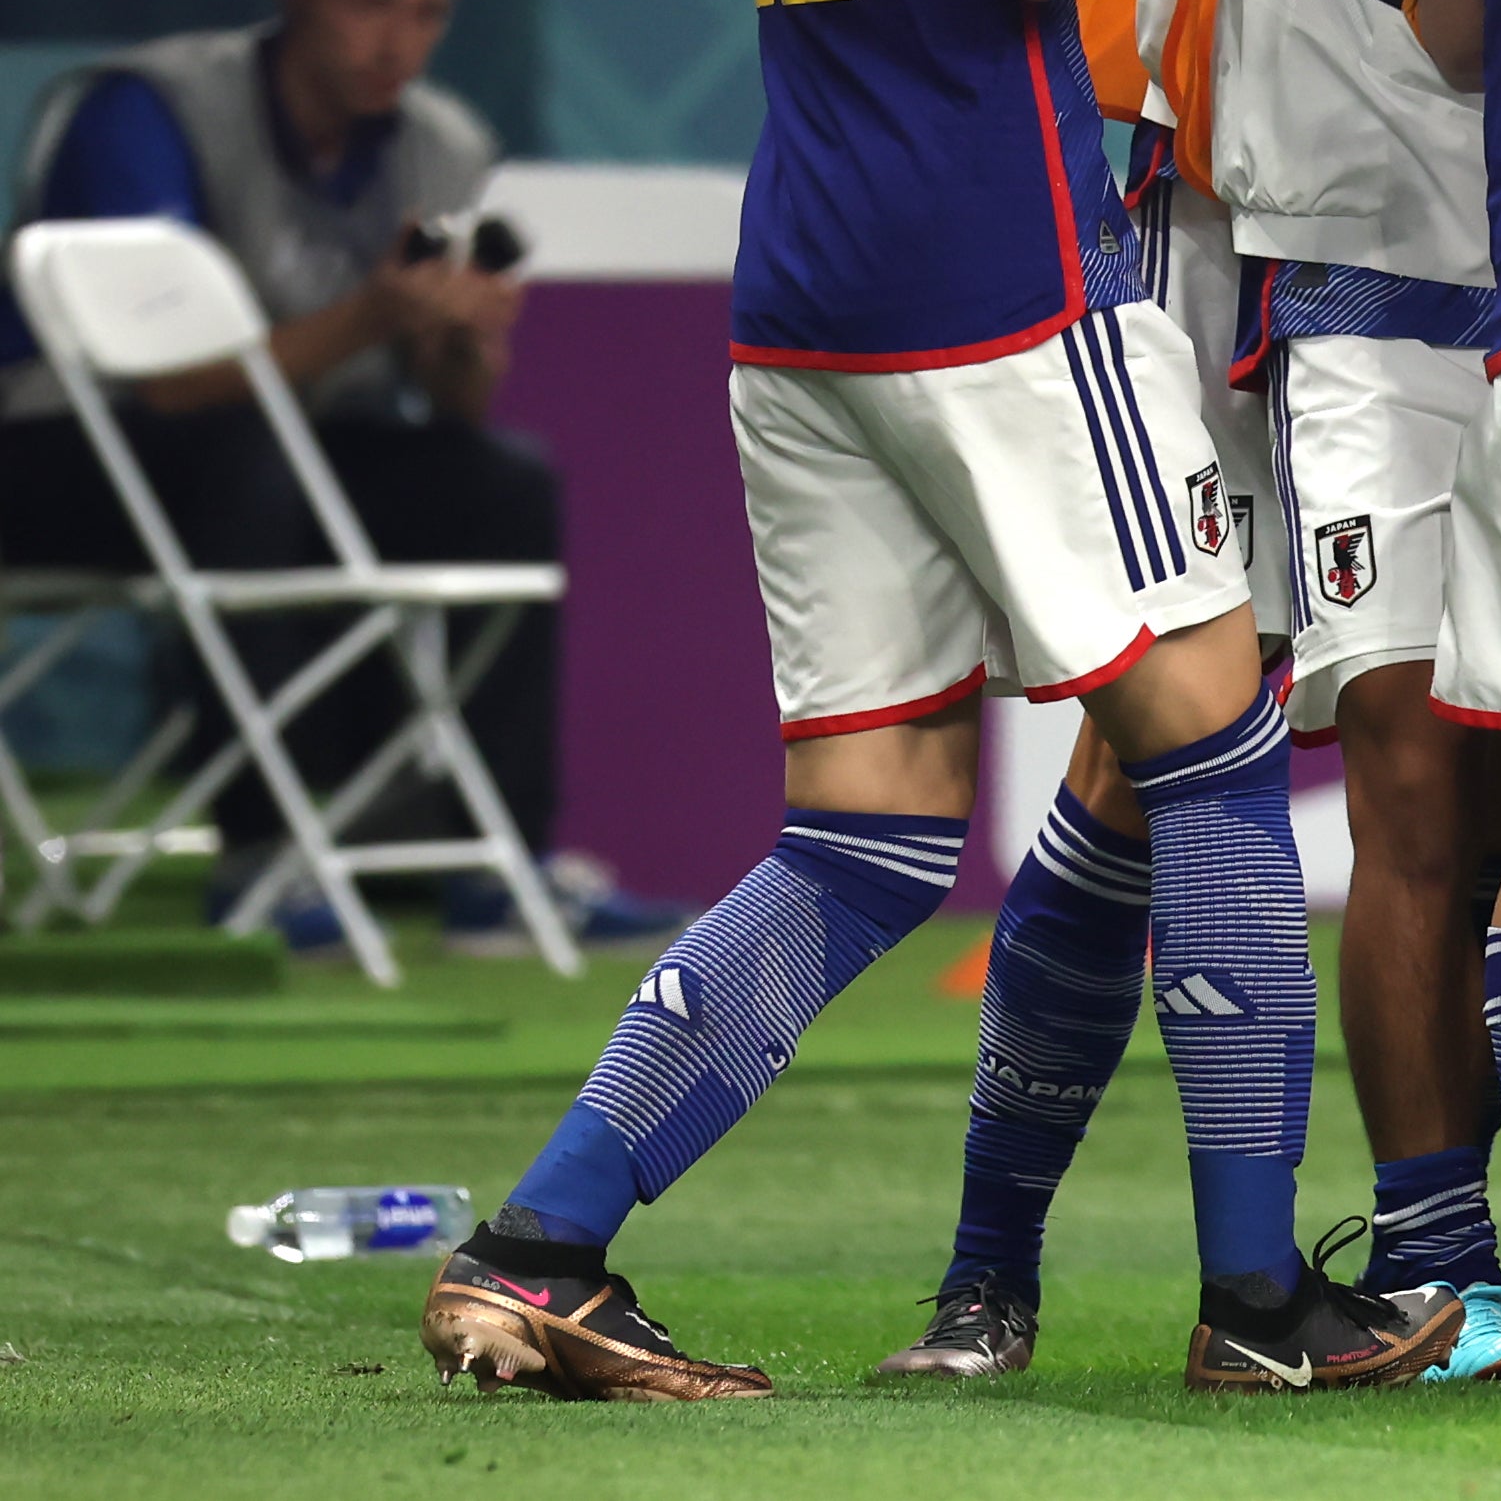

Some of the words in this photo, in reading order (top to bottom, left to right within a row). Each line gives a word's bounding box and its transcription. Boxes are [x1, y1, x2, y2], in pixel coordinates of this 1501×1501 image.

[1196, 467, 1215, 483] JAPAN
[1325, 520, 1357, 535] JAPAN
[982, 1055, 1105, 1101] JAPAN
